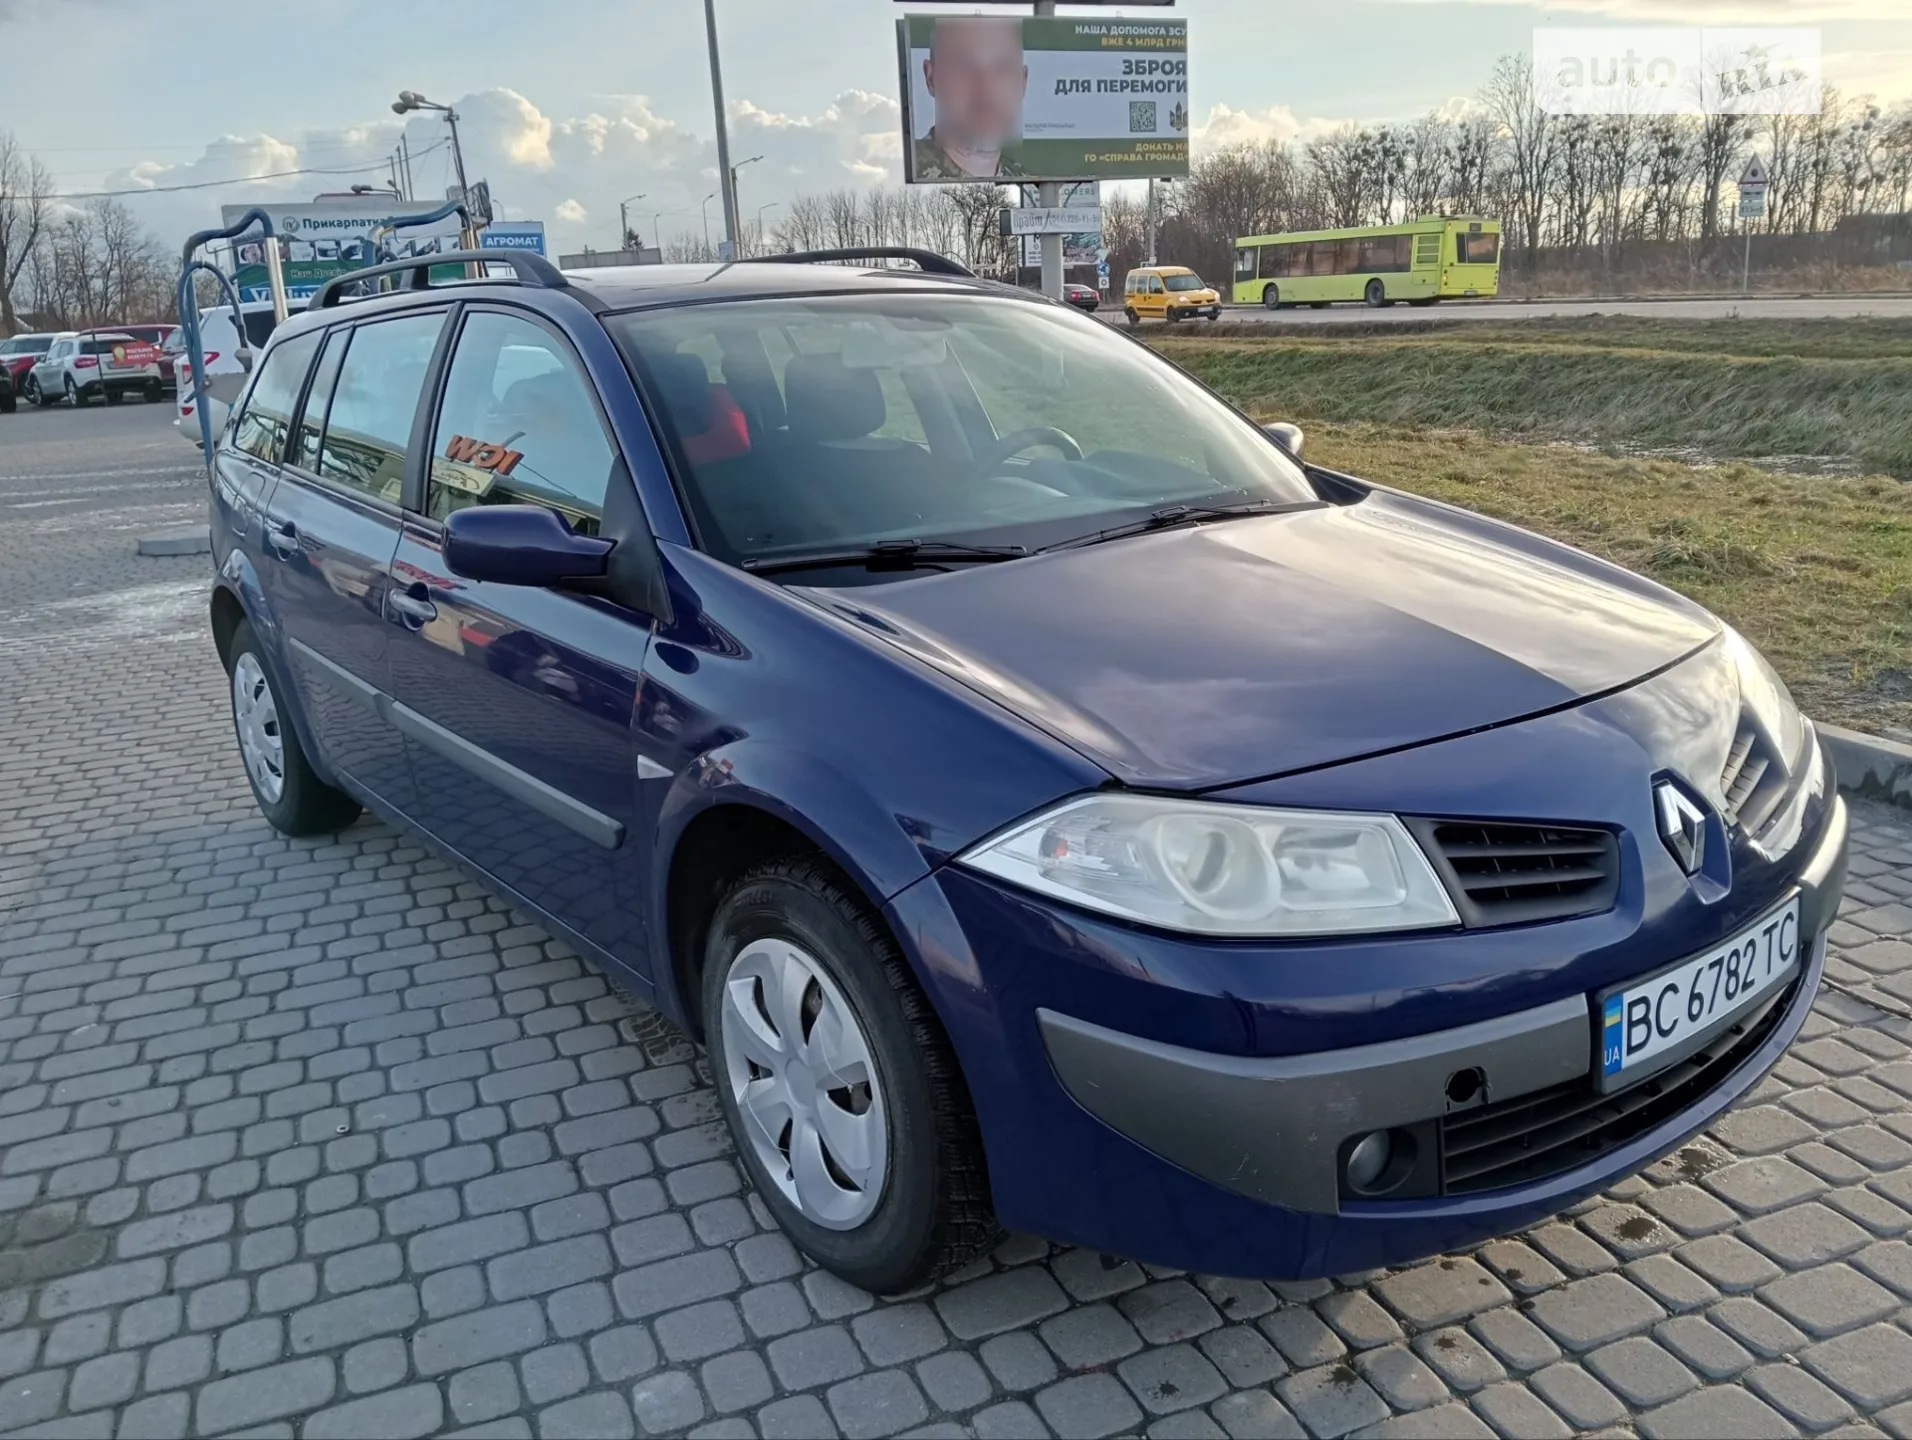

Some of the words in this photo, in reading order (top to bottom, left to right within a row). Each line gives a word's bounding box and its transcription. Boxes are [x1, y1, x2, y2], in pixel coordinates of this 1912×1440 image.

[1075, 25, 1108, 35] НАША
[1110, 26, 1166, 36] ДОПОМОГА
[1169, 27, 1187, 36] ЗСУ
[1101, 37, 1124, 46] ВЖЕ
[1135, 38, 1164, 48] МЛРД
[1166, 38, 1185, 47] ГРН
[1122, 59, 1187, 75] ЗБРОЯ
[1054, 79, 1092, 95] ДЛЯ
[1097, 79, 1187, 93] ПЕРЕМОГИ
[1136, 143, 1174, 152] ДОНАТЬ
[1084, 154, 1097, 162] ГО
[486, 236, 538, 246] АГРОМАТ
[1626, 982, 1680, 1057] BC
[1687, 938, 1757, 1023] 6782
[1762, 911, 1795, 975] TC
[1604, 1047, 1620, 1066] UA
